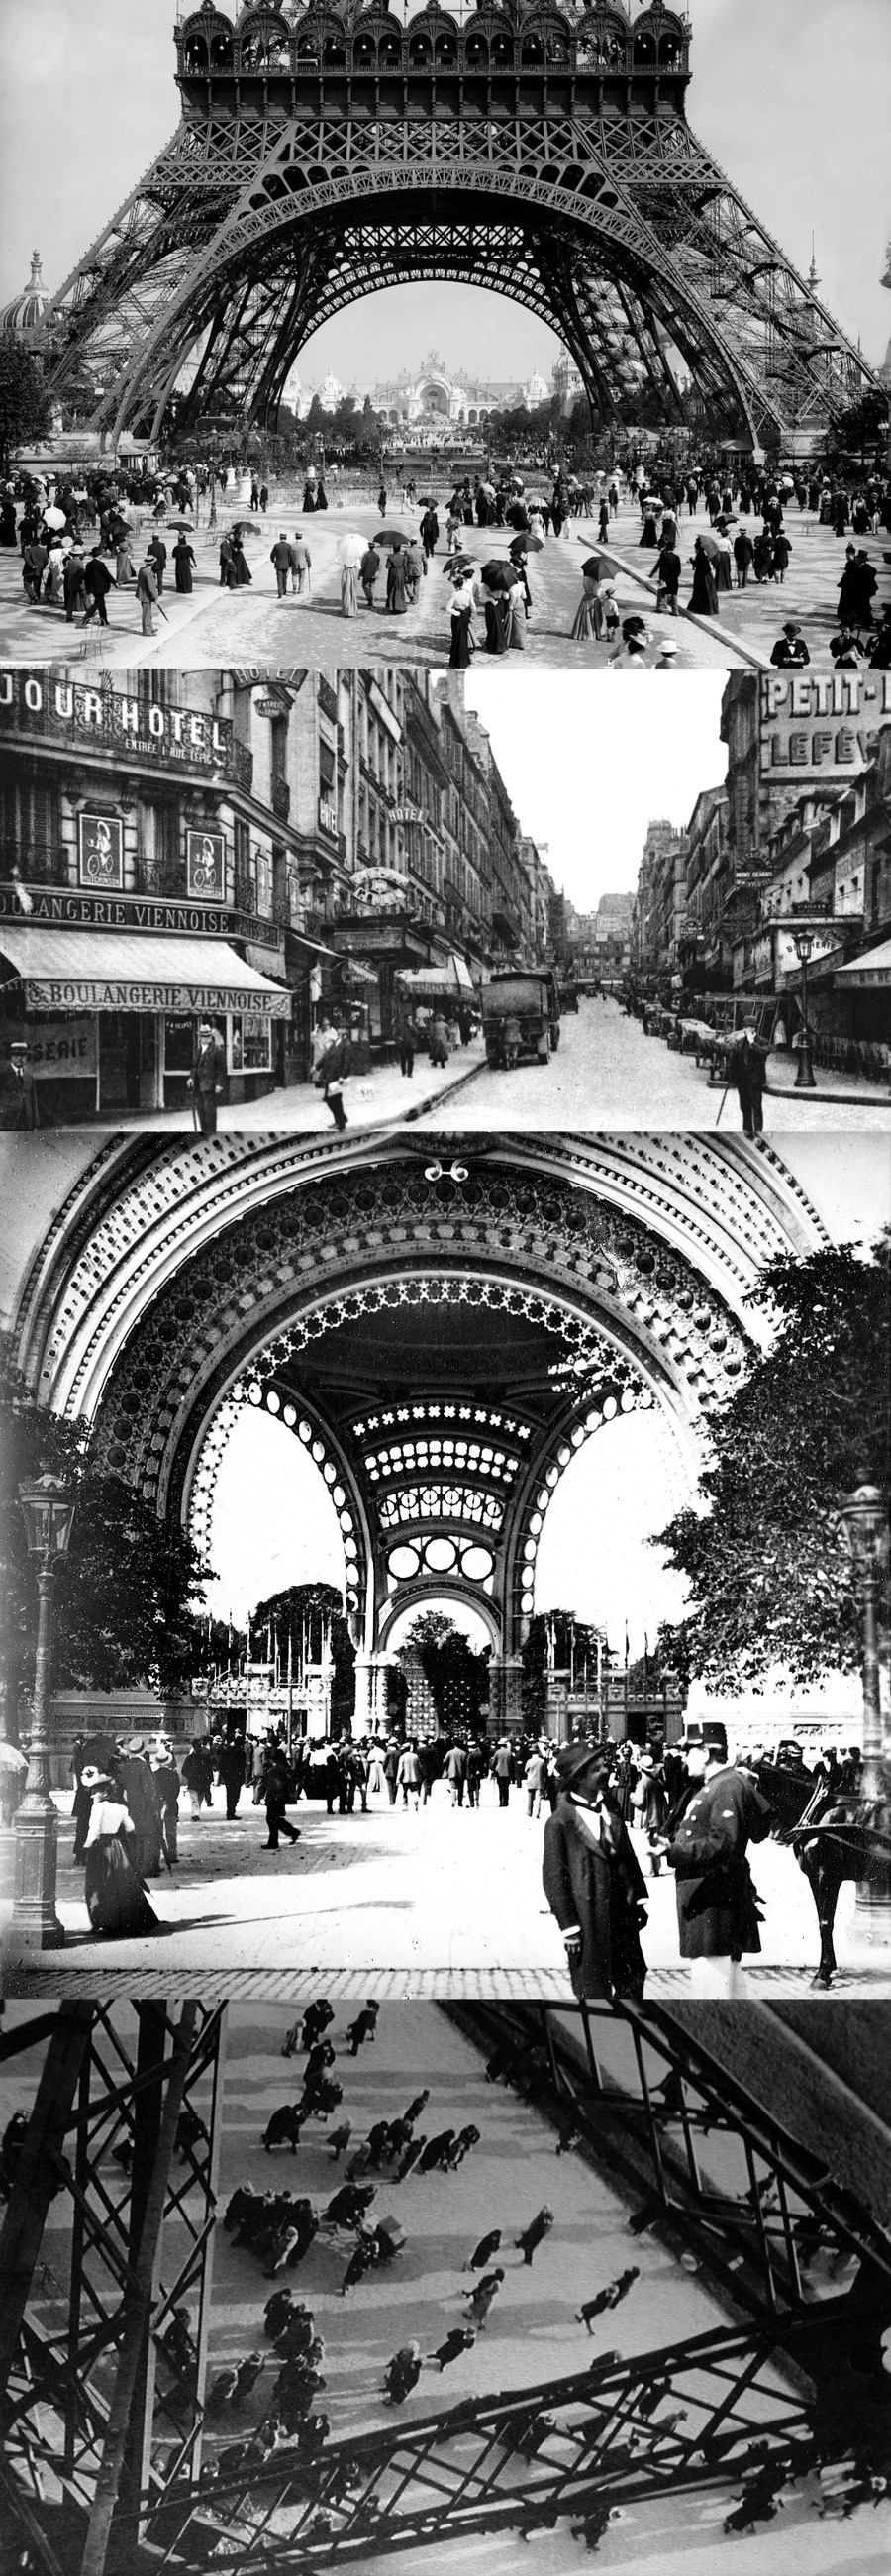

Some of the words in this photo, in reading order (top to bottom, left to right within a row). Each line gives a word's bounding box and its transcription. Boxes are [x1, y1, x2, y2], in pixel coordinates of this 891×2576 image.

[170, 748, 186, 760] RUE
[388, 808, 424, 822] HOTEL
[134, 906, 229, 933] VIENNOISE
[786, 941, 836, 953] BOHERIE
[50, 983, 181, 1006] BOULANGERIE
[188, 990, 272, 1011] VIENNOISE
